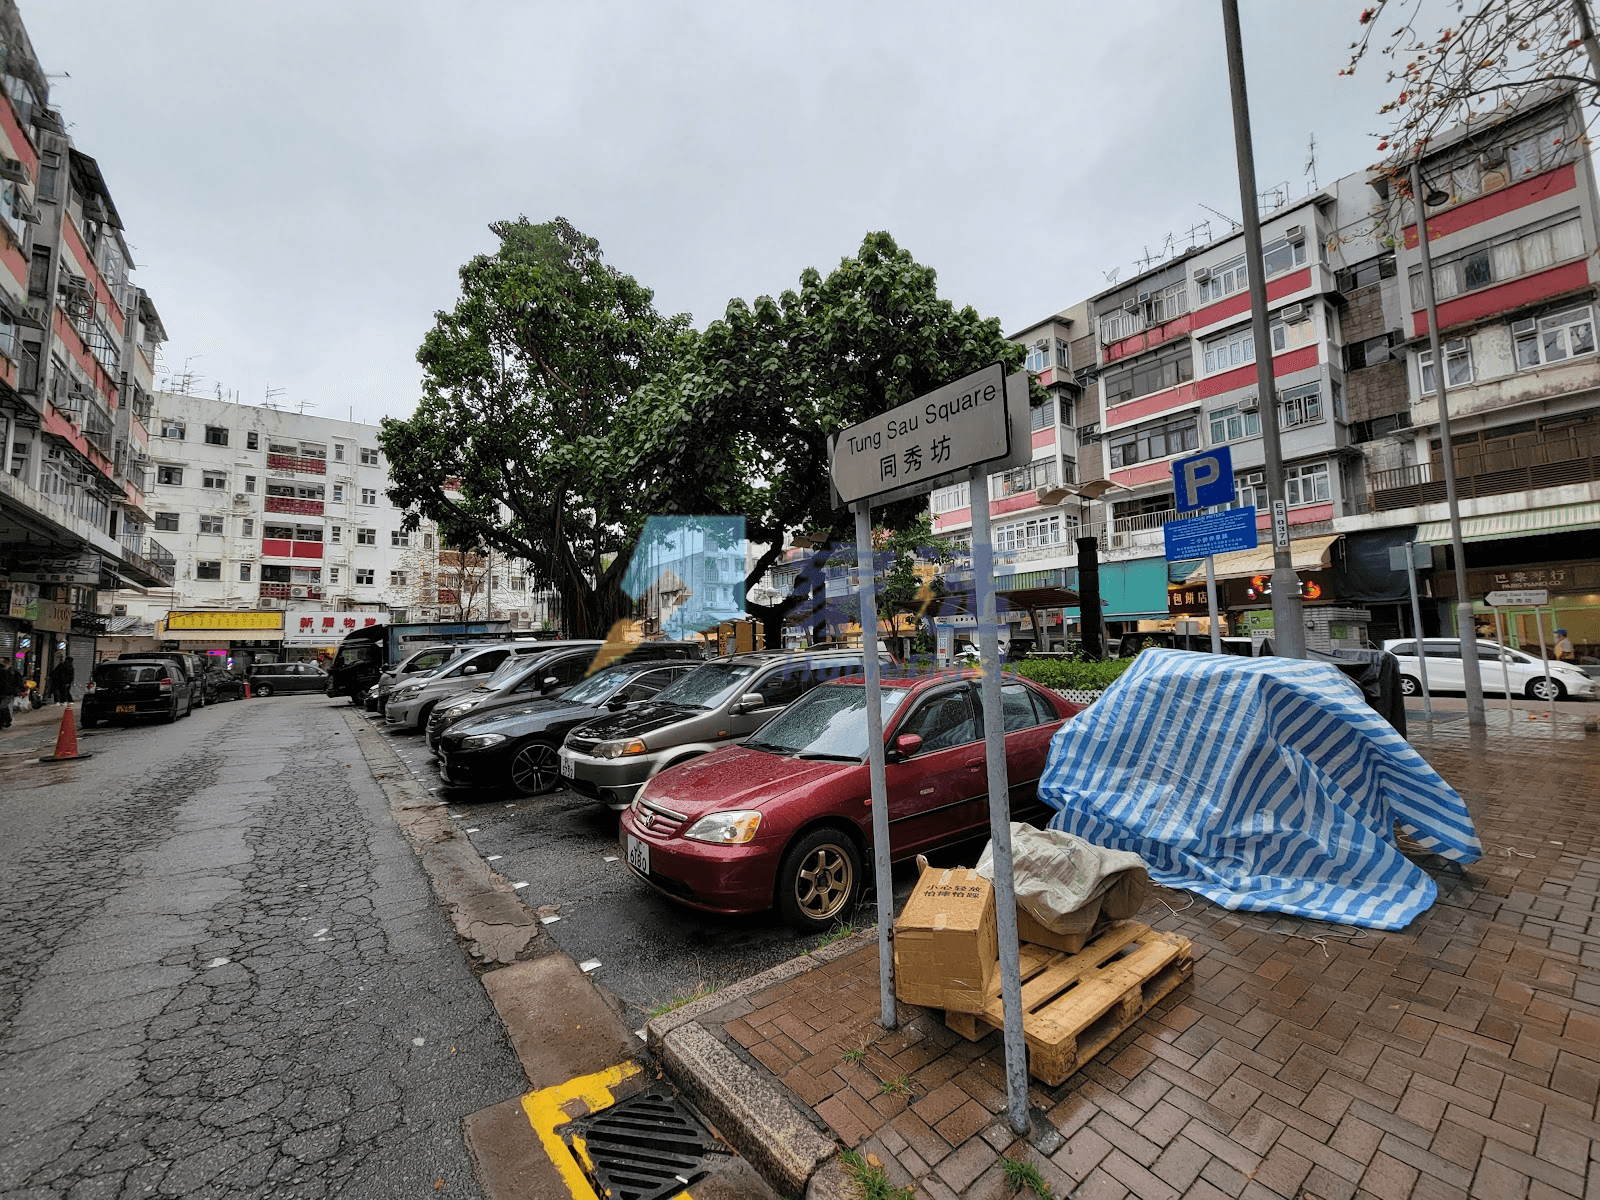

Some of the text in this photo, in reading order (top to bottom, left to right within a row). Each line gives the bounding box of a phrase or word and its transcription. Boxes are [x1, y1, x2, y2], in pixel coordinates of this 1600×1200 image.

[847, 384, 997, 456] Tung Sau Square
[880, 434, 952, 482] 同秀坊
[1183, 456, 1221, 507] P
[1277, 519, 1287, 546] 0376
[41, 558, 96, 569] PEPSI
[630, 849, 647, 872] 6180
